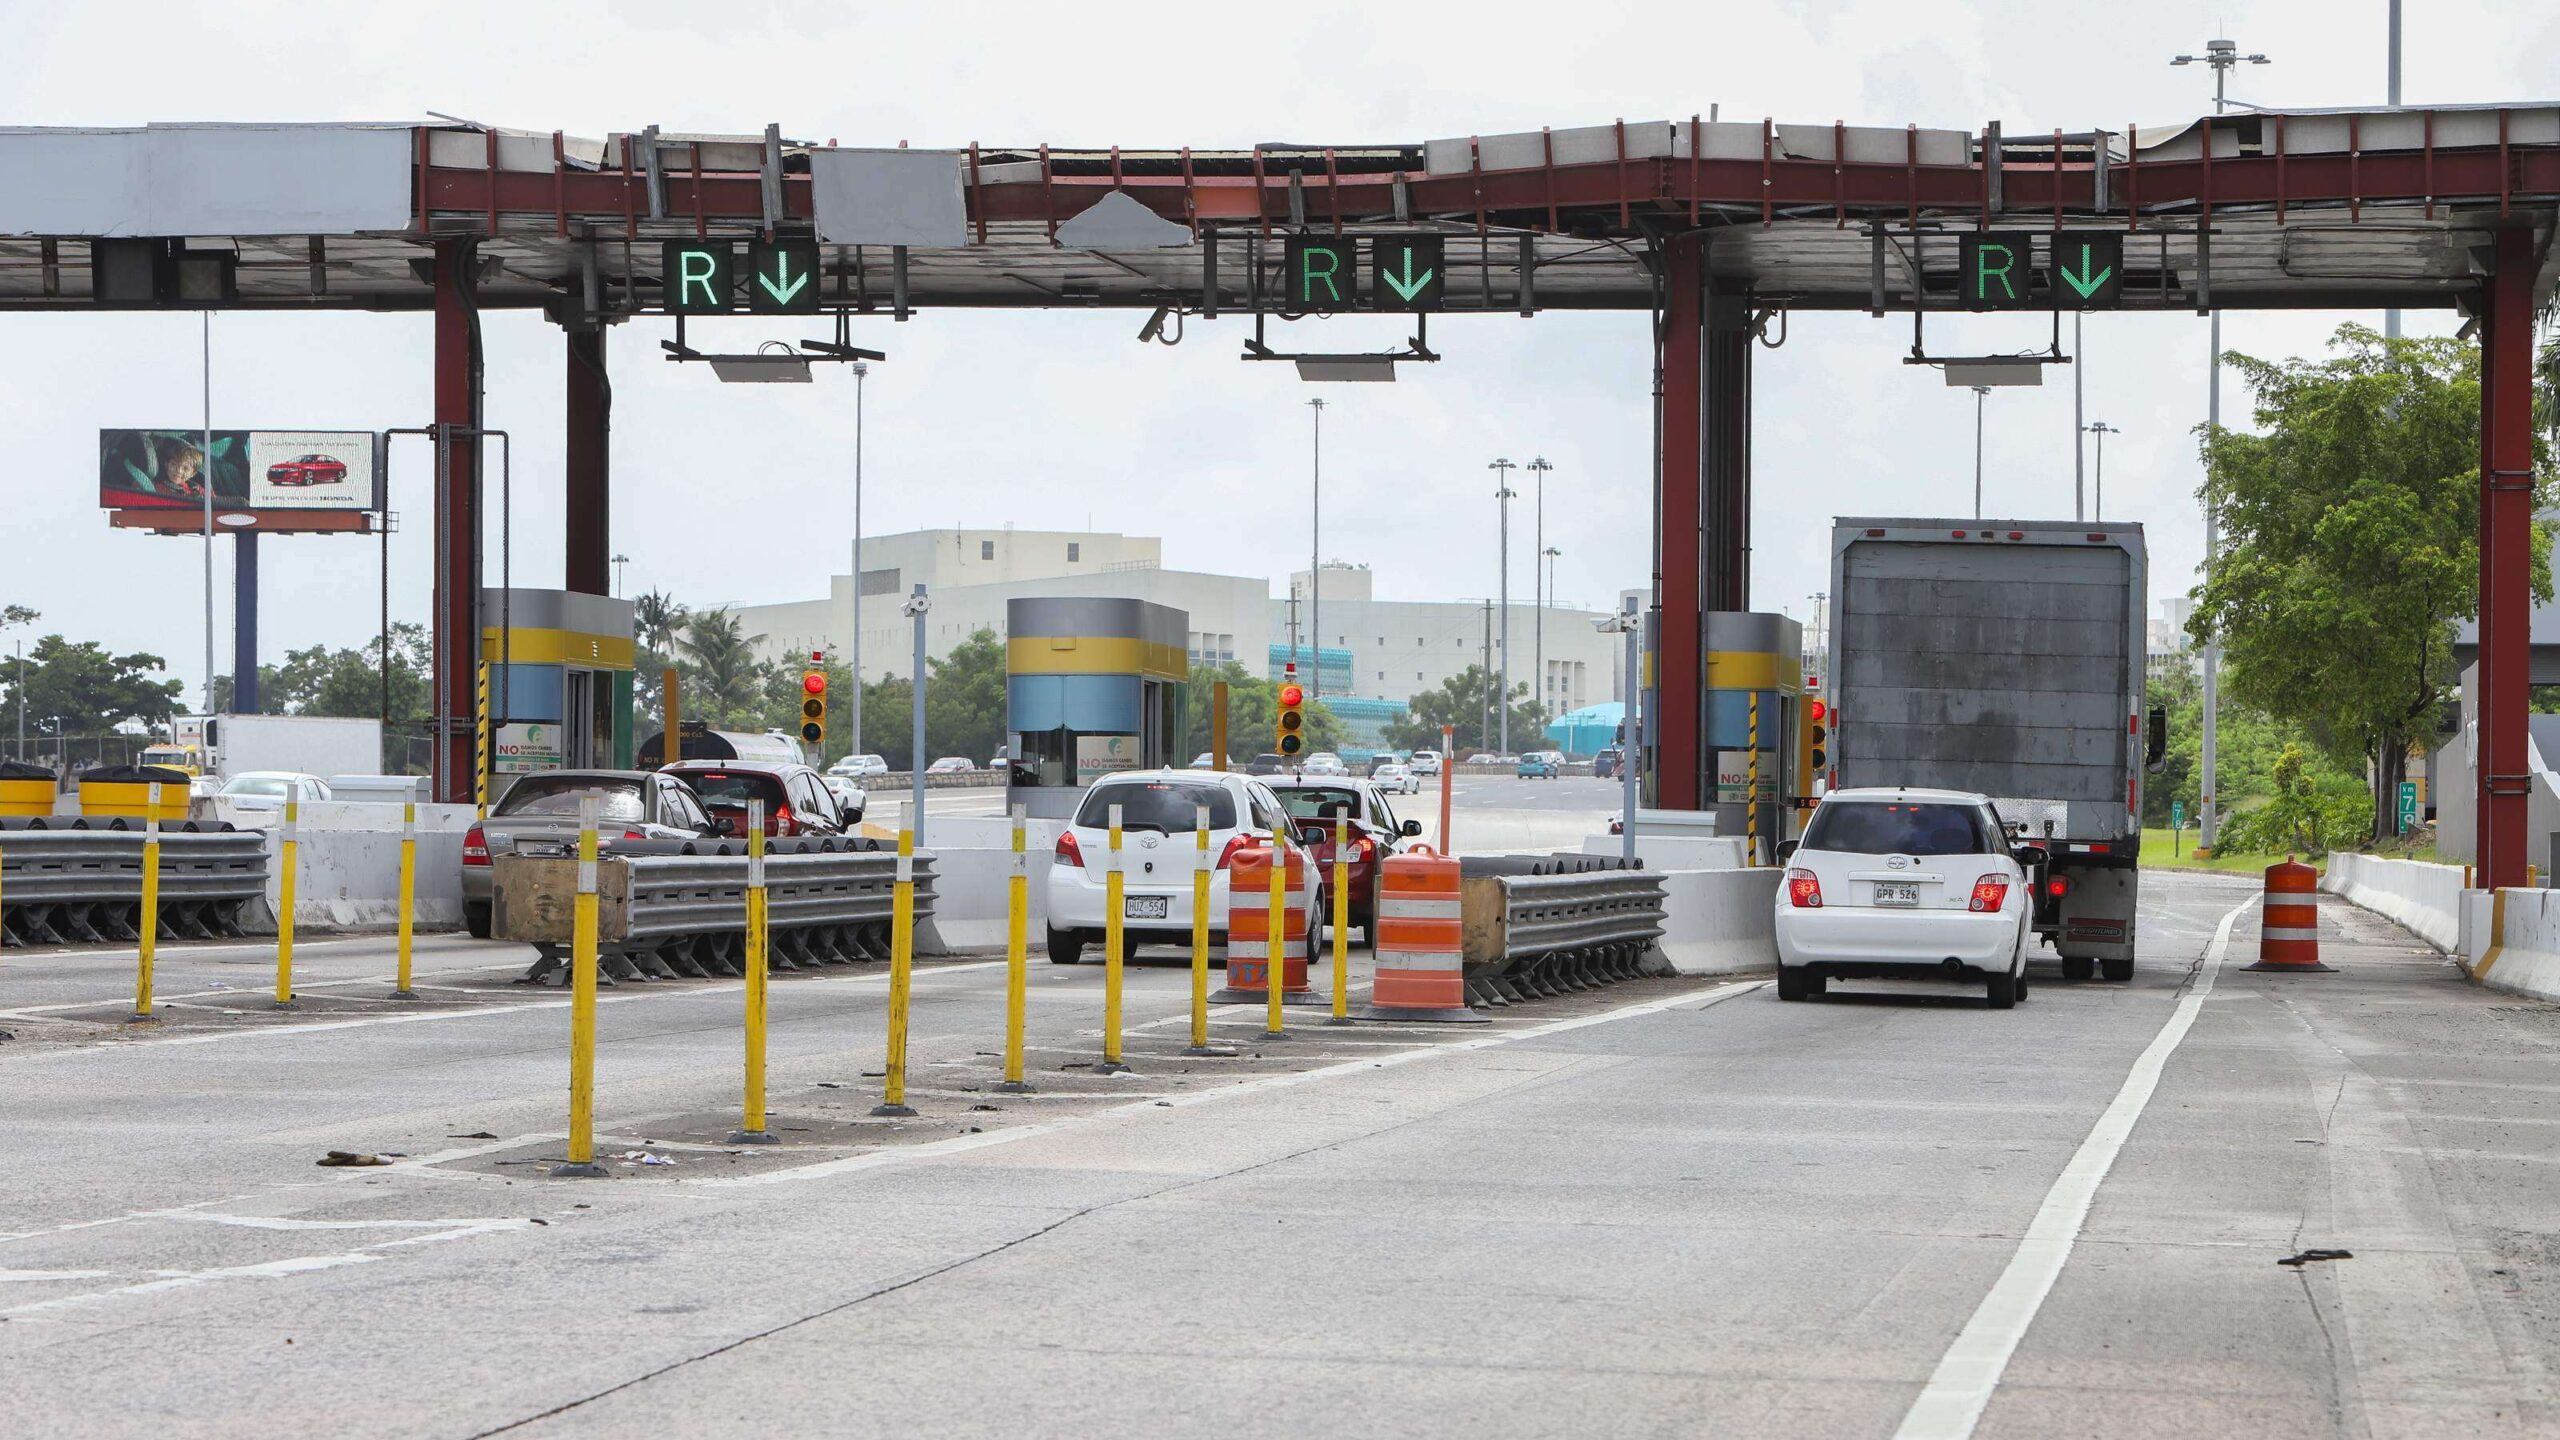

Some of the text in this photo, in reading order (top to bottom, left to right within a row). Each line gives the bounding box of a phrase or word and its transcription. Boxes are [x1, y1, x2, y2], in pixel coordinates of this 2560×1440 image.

[681, 251, 718, 305] R
[1304, 248, 1341, 302] R
[1978, 245, 2015, 299] R
[499, 744, 519, 755] NO
[1080, 758, 1101, 769] NO
[1721, 774, 1741, 784] NO
[2402, 795, 2414, 811] 7
[2175, 809, 2181, 818] 7
[1876, 888, 1917, 900] GPR 526
